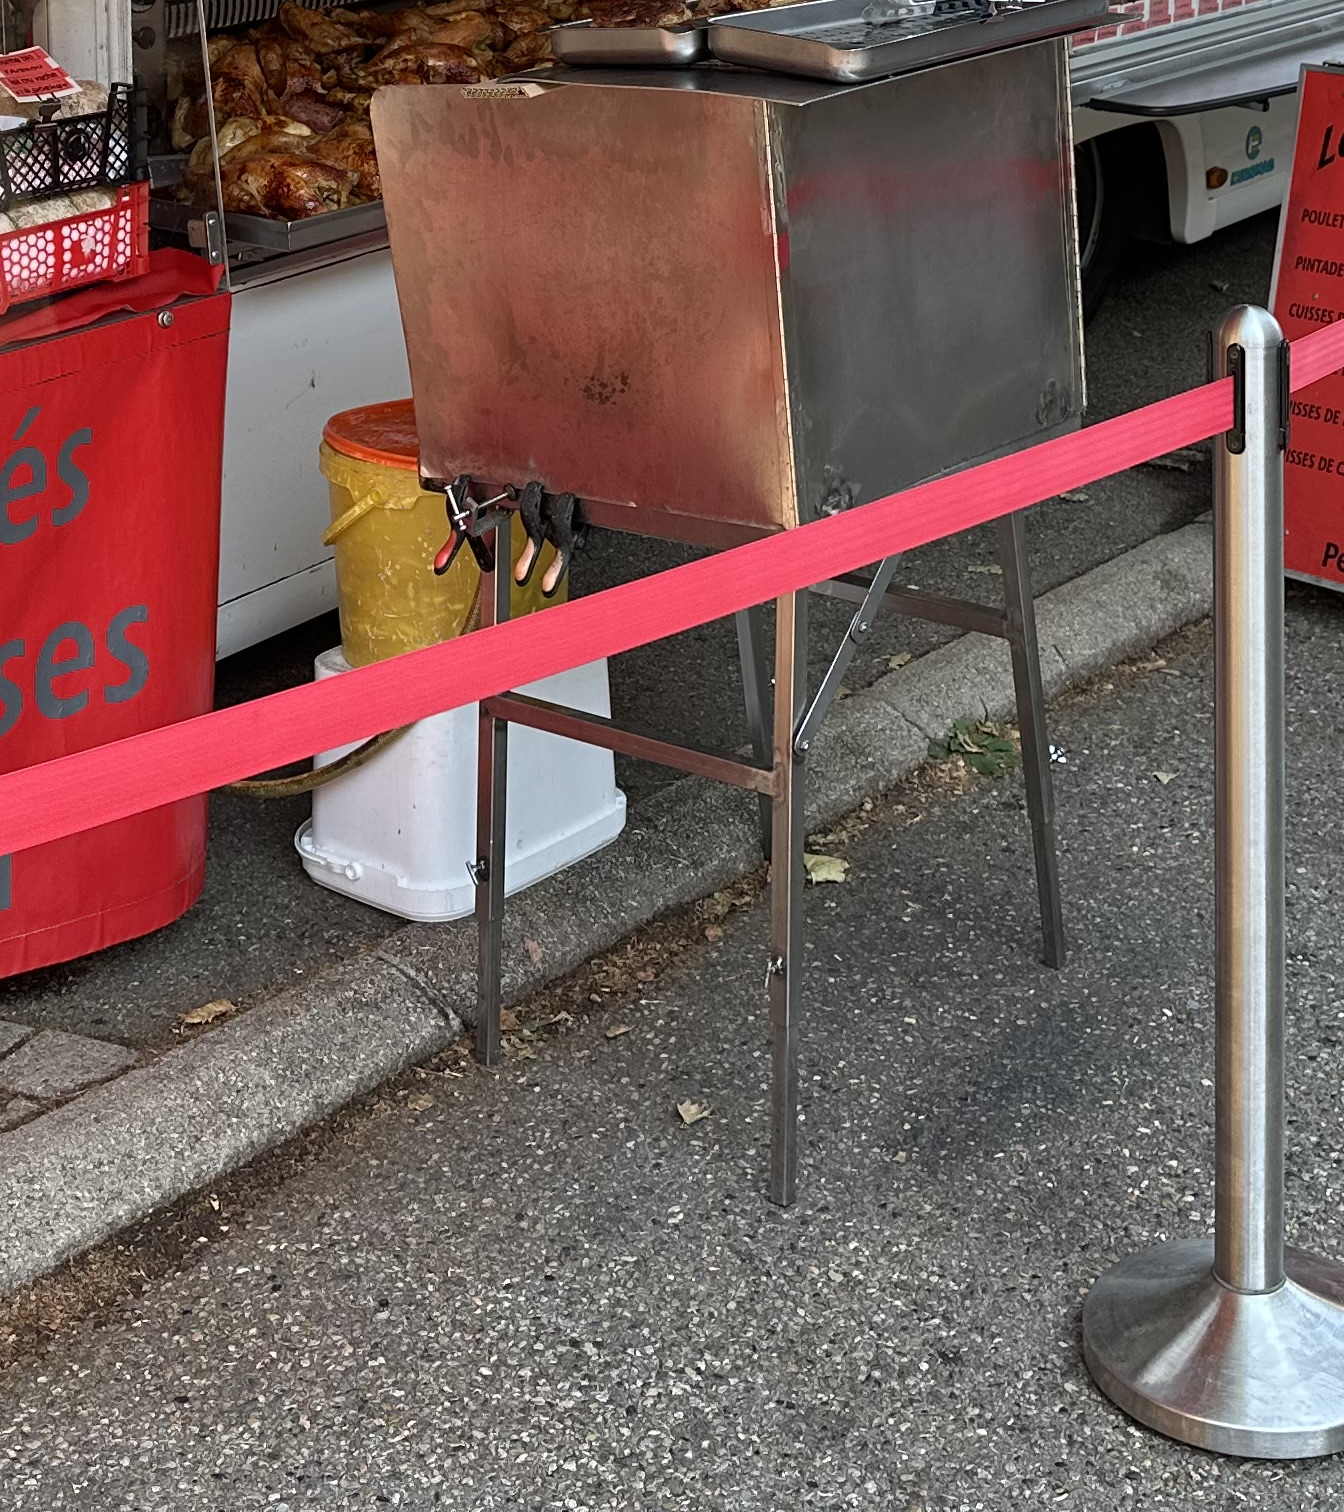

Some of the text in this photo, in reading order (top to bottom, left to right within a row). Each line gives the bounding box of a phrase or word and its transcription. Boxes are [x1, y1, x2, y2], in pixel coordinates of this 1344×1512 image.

[1295, 256, 1344, 278] PINTADE
[1289, 303, 1333, 325] CUISSES
[1323, 408, 1339, 425] DE
[1318, 456, 1334, 474] DE
